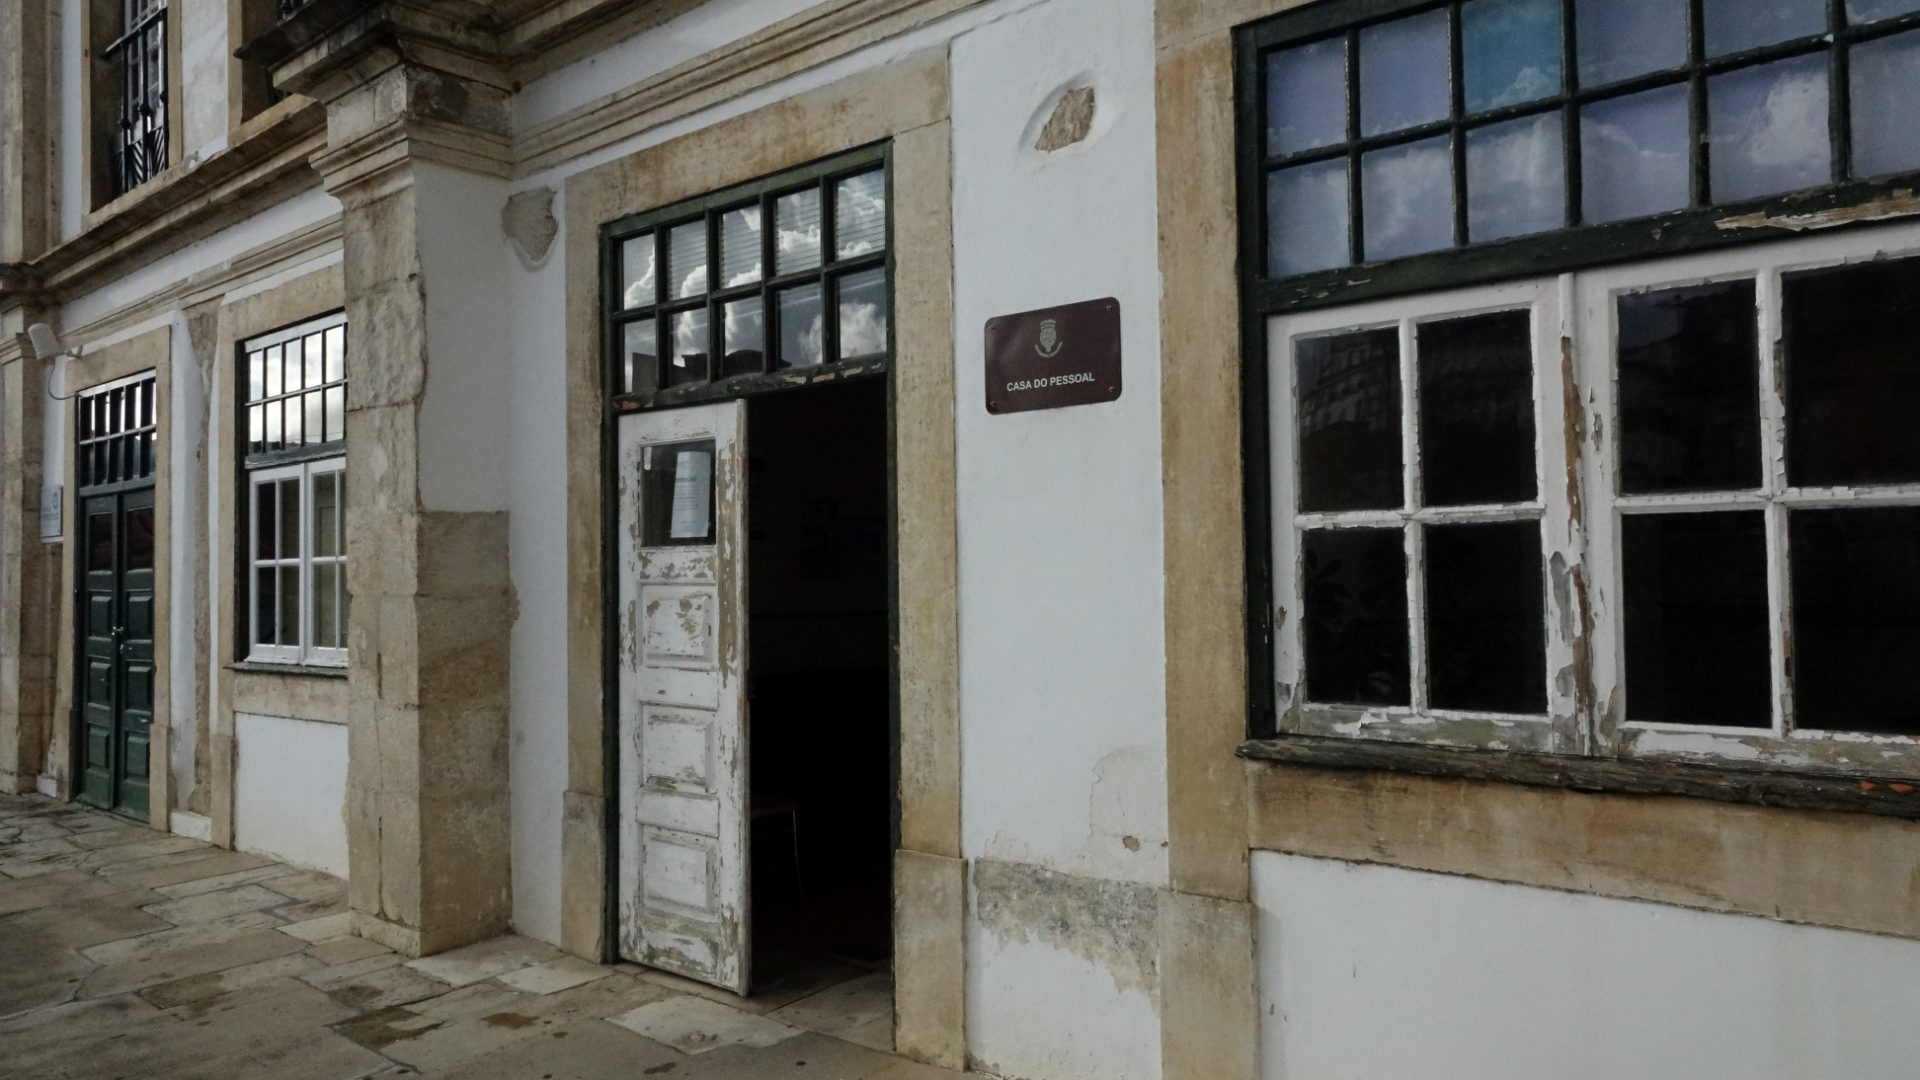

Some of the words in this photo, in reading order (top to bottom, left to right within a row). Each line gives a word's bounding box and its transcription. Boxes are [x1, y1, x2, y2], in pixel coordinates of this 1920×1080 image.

[1007, 380, 1032, 392] CASA
[1034, 378, 1047, 388] DO
[1050, 372, 1096, 386] PESSOAL
